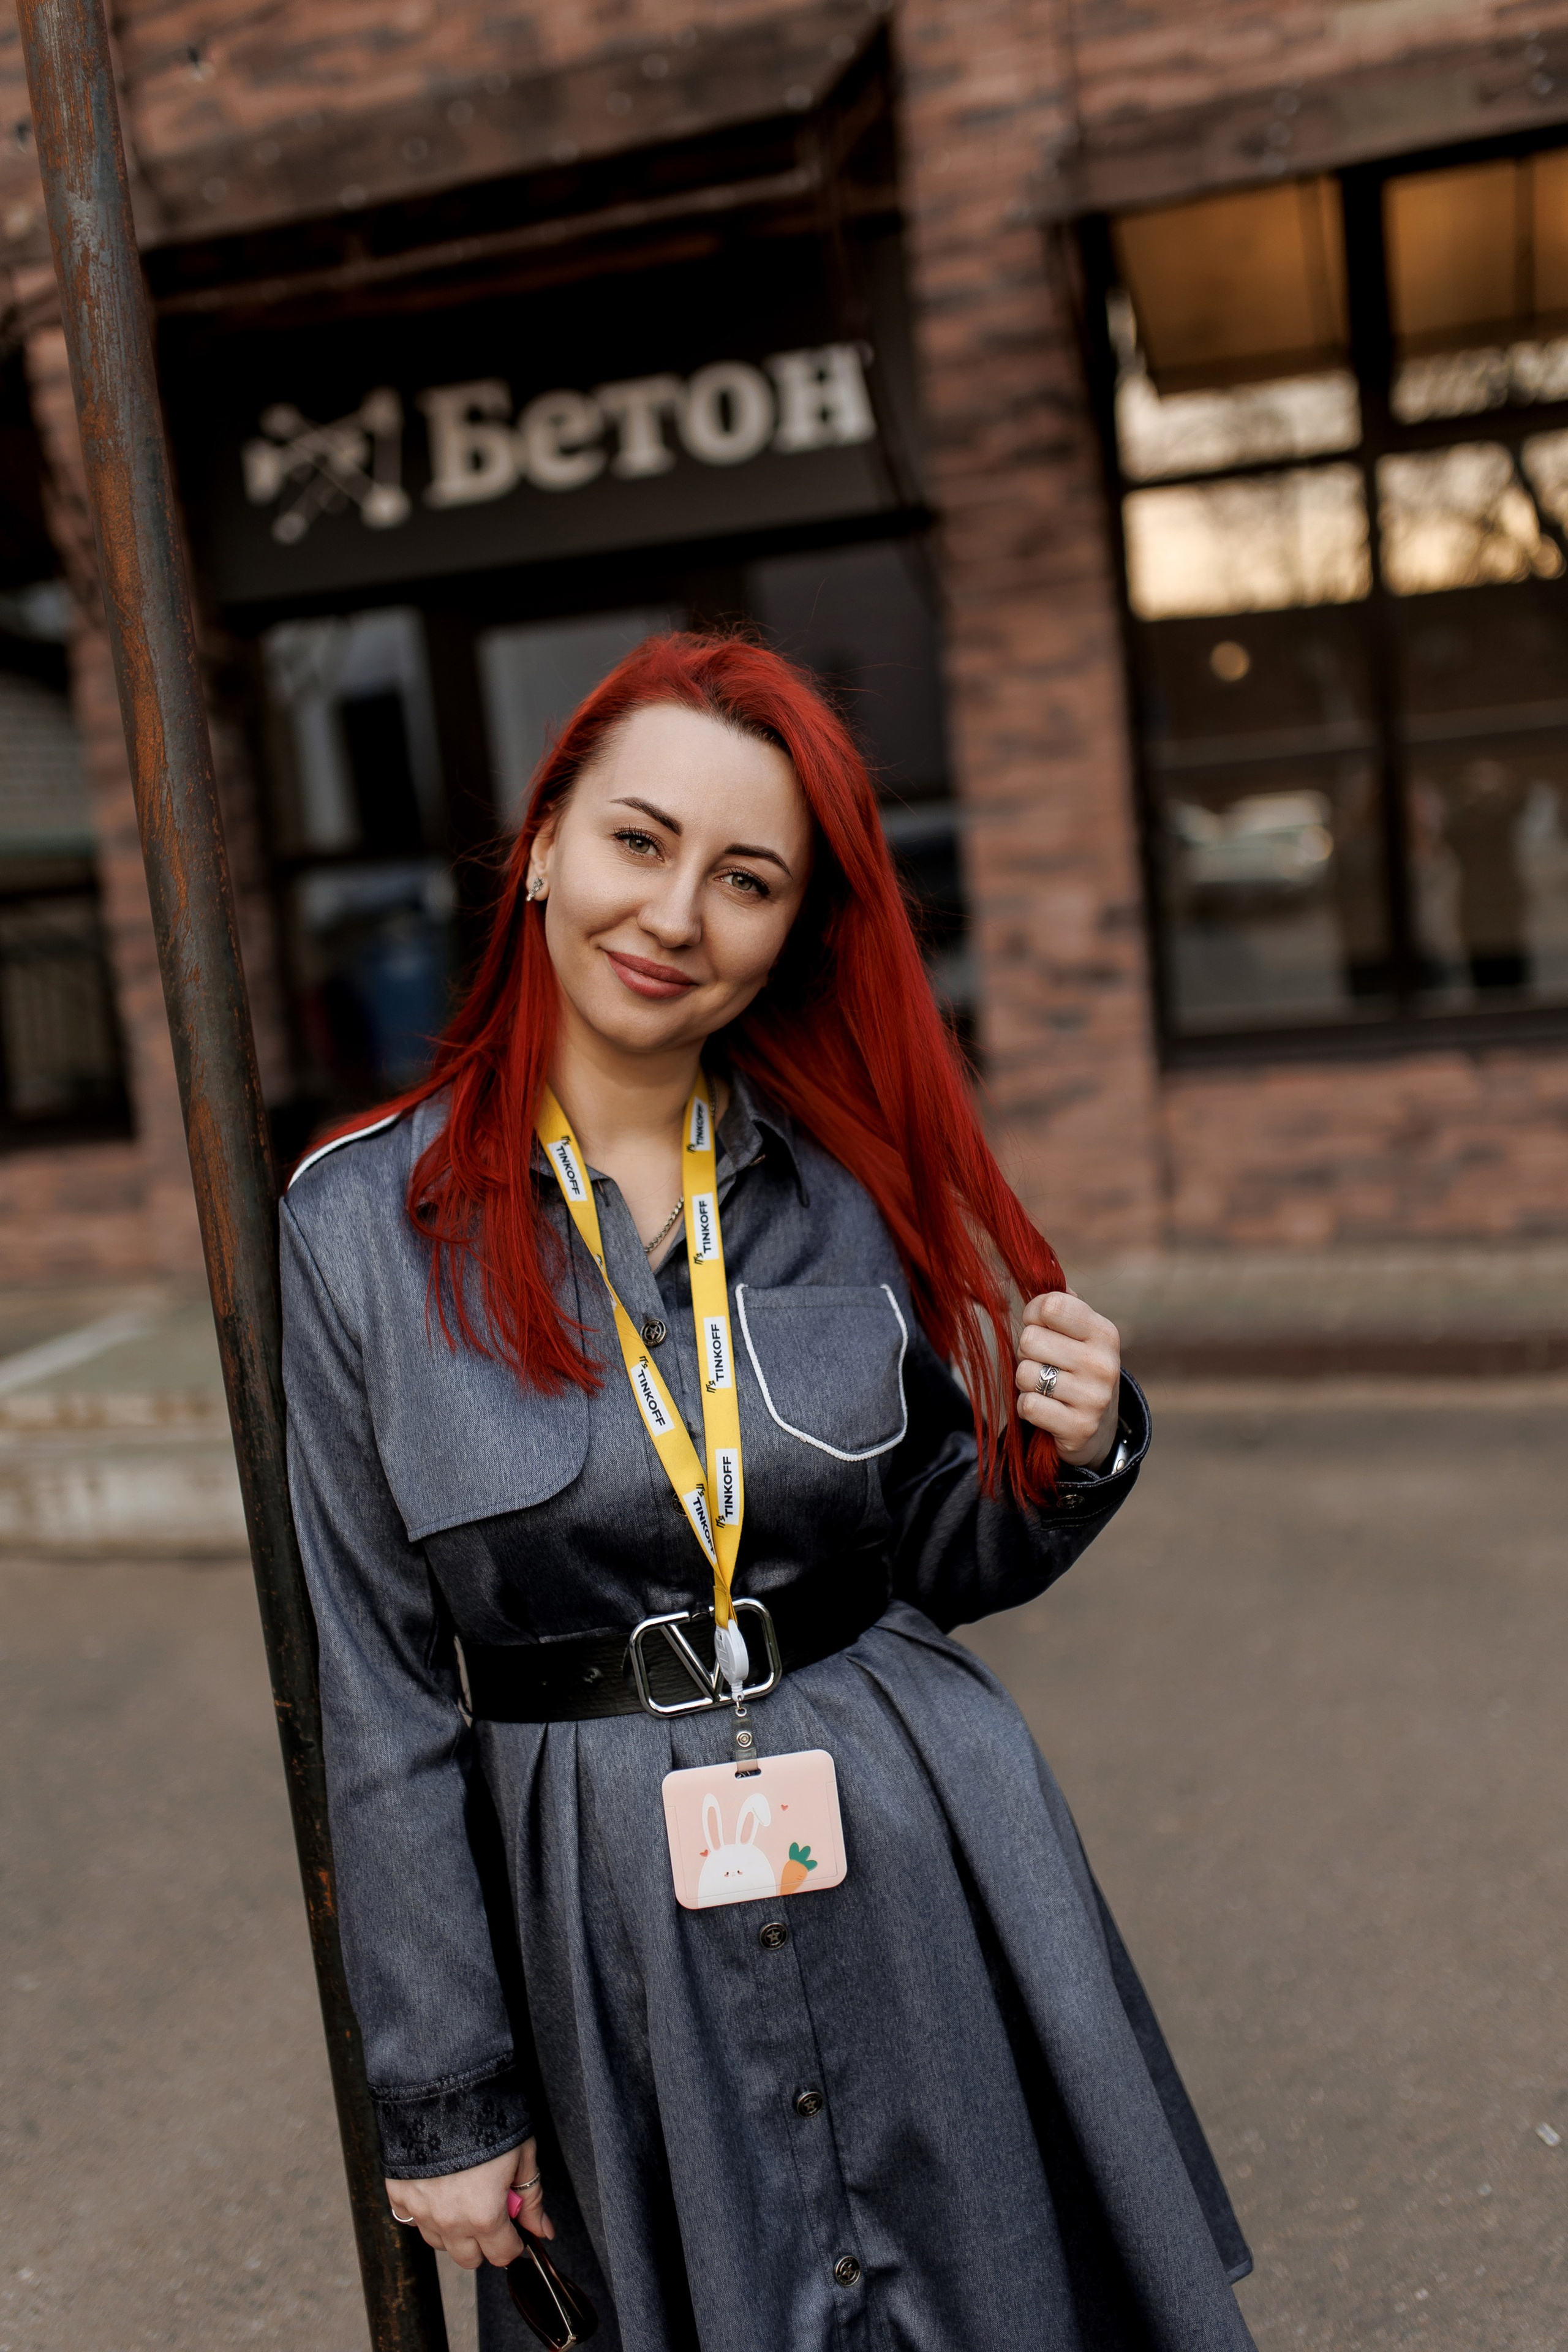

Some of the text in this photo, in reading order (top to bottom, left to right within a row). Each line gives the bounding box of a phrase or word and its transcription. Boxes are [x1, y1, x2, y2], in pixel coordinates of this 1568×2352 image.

[418, 341, 876, 509] Бетон
[696, 1104, 704, 1146] TINKOFF
[556, 1145, 580, 1196] TINKOFF
[699, 1200, 711, 1253] TINKOFF
[711, 1324, 724, 1381] TINKOFF
[638, 1370, 666, 1426] TINKOFF
[723, 1457, 733, 1517] TINKOFF
[693, 1497, 715, 1555] TINKOFF
